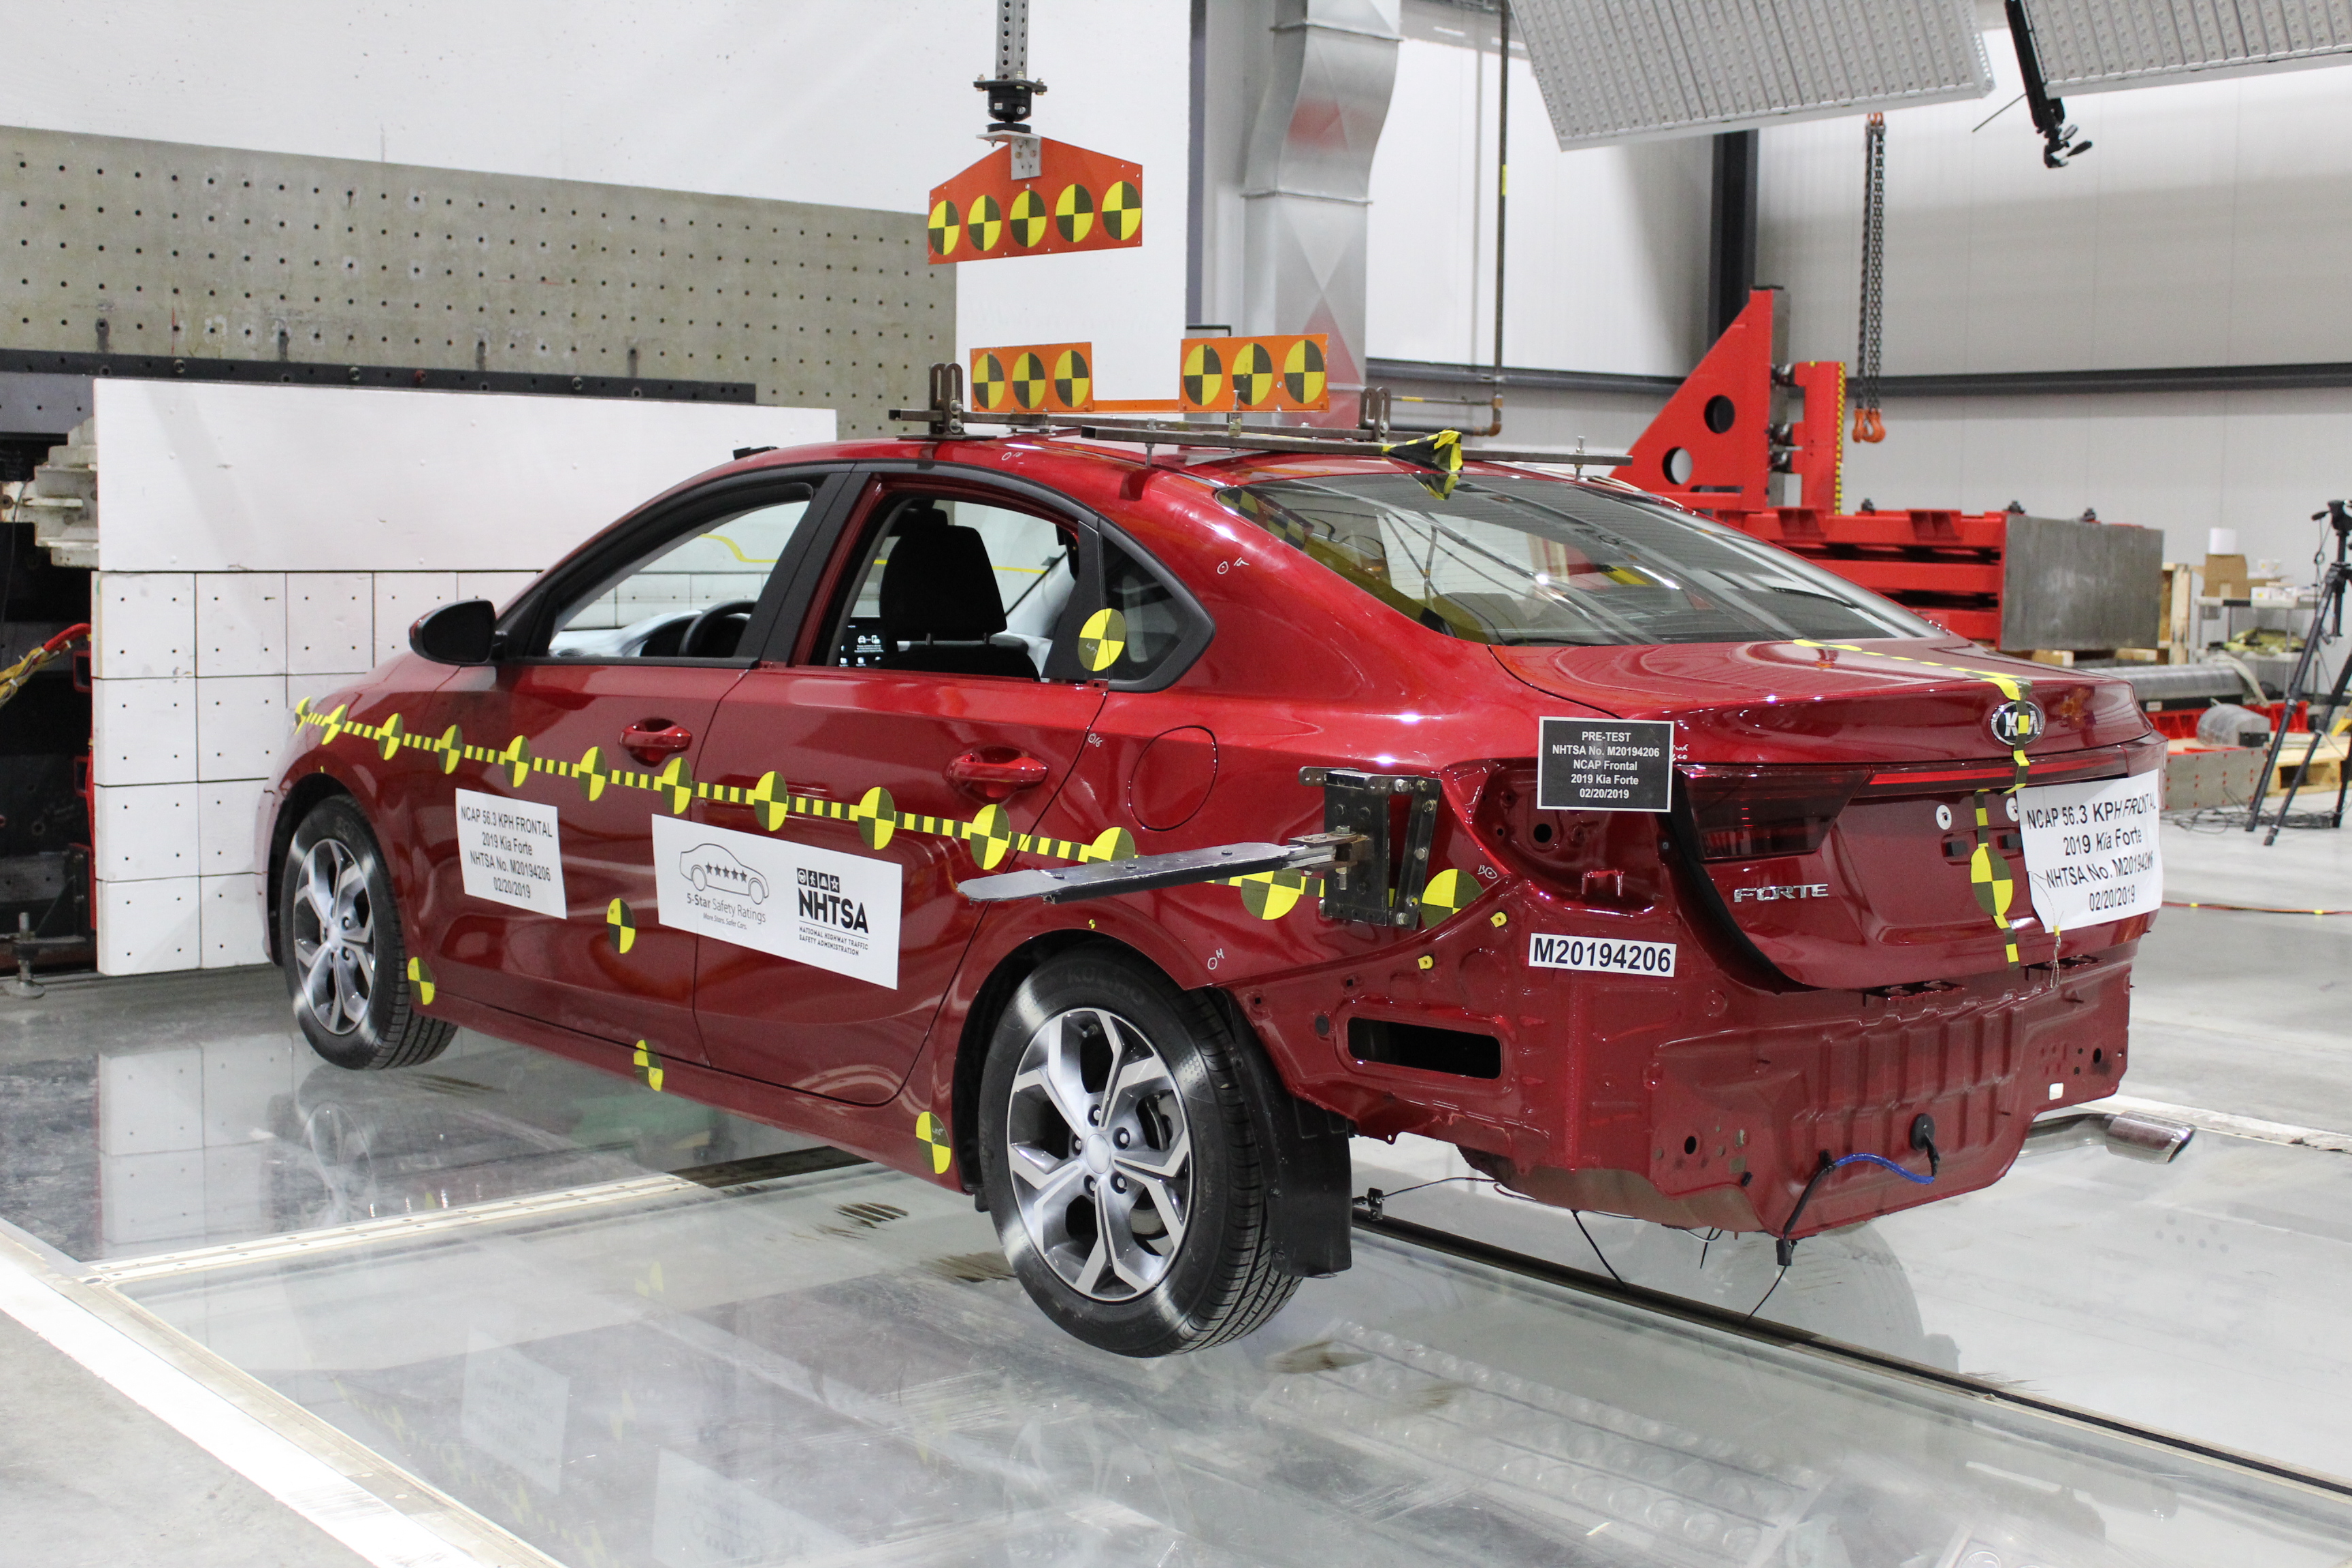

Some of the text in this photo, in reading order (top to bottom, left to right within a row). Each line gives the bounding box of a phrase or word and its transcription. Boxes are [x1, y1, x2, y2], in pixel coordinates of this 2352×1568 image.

[2004, 710, 2038, 736] KA
[1582, 731, 1631, 742] PRE-TEST
[1552, 745, 1660, 757] NHTSA No. M20194206
[1573, 760, 1638, 771] NCAP Frontal
[1571, 774, 1639, 785] 2019 Kia Forte
[1579, 788, 1629, 799] 02/20/2019
[461, 806, 553, 837] NCAP 56.3 KPH FRONTAL
[2027, 807, 2059, 829] NCAP
[2062, 804, 2088, 826] 56.3
[2092, 800, 2123, 822] KPH
[482, 832, 532, 855] 2019 Kia Forte
[2063, 827, 2142, 855] 2019 Kia Forte
[470, 850, 551, 881] NHTSA No. M20194206
[2046, 866, 2089, 889] NHTSA
[2087, 863, 2112, 881] No.
[493, 877, 531, 898] 02/20/2019
[1733, 883, 1829, 902] FORTE
[2089, 885, 2135, 911] 02/20/2019
[687, 892, 766, 924] 5-Star Safety Ratings
[798, 887, 868, 934] NHTSA
[703, 912, 747, 930] More Stars. Safer Cars.
[799, 926, 868, 950] NATIONAL HIGHWAY TRAFFIC
[799, 934, 859, 956] SAFETY ADMINISTRATION
[1533, 937, 1671, 973] M20194206
